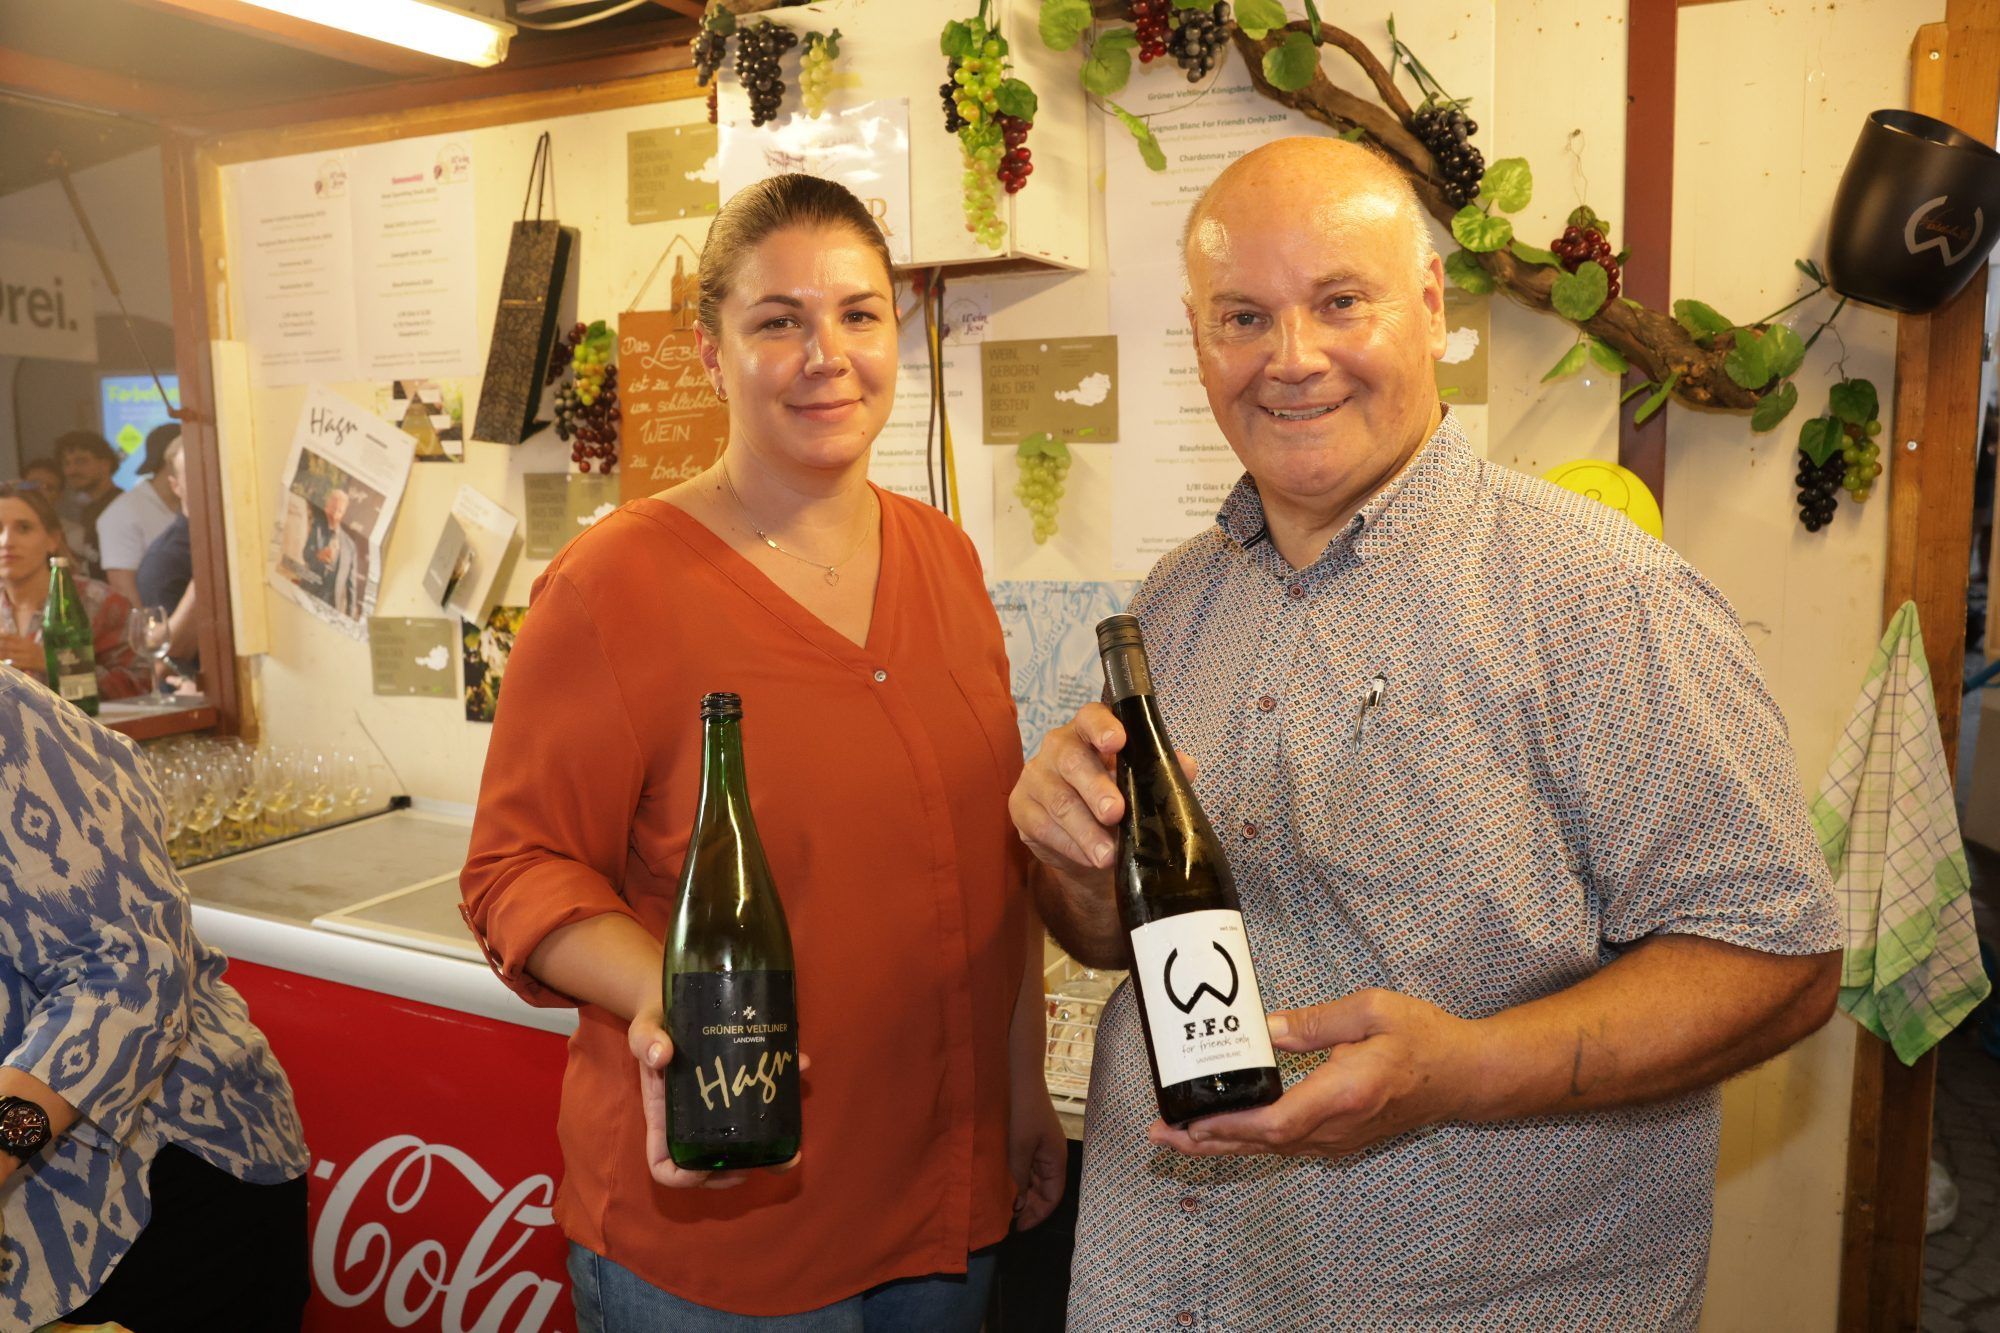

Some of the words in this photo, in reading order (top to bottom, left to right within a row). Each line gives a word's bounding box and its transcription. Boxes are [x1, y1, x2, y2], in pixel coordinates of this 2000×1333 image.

[1147, 90, 1175, 102] Grüner
[1179, 121, 1201, 132] Blanc
[1202, 120, 1215, 129] For
[1217, 117, 1246, 128] Friends
[1247, 115, 1267, 126] Only
[1267, 113, 1287, 123] 2024
[1179, 153, 1225, 163] Chardonnay
[0, 277, 78, 331] rei.
[640, 334, 702, 370] LEBE
[990, 363, 1040, 378] GEBOREN
[990, 381, 1012, 395] AUS
[1015, 380, 1036, 394] DER
[990, 398, 1030, 412] BESTEN
[309, 406, 359, 446] Hagn
[639, 420, 691, 444] WEIN
[702, 1024, 744, 1035] GRÜNER
[746, 1023, 788, 1034] VELTLINER
[1184, 1015, 1239, 1040] F.F.O
[733, 1036, 766, 1044] LANDWEIN
[695, 1051, 793, 1111] Hagn
